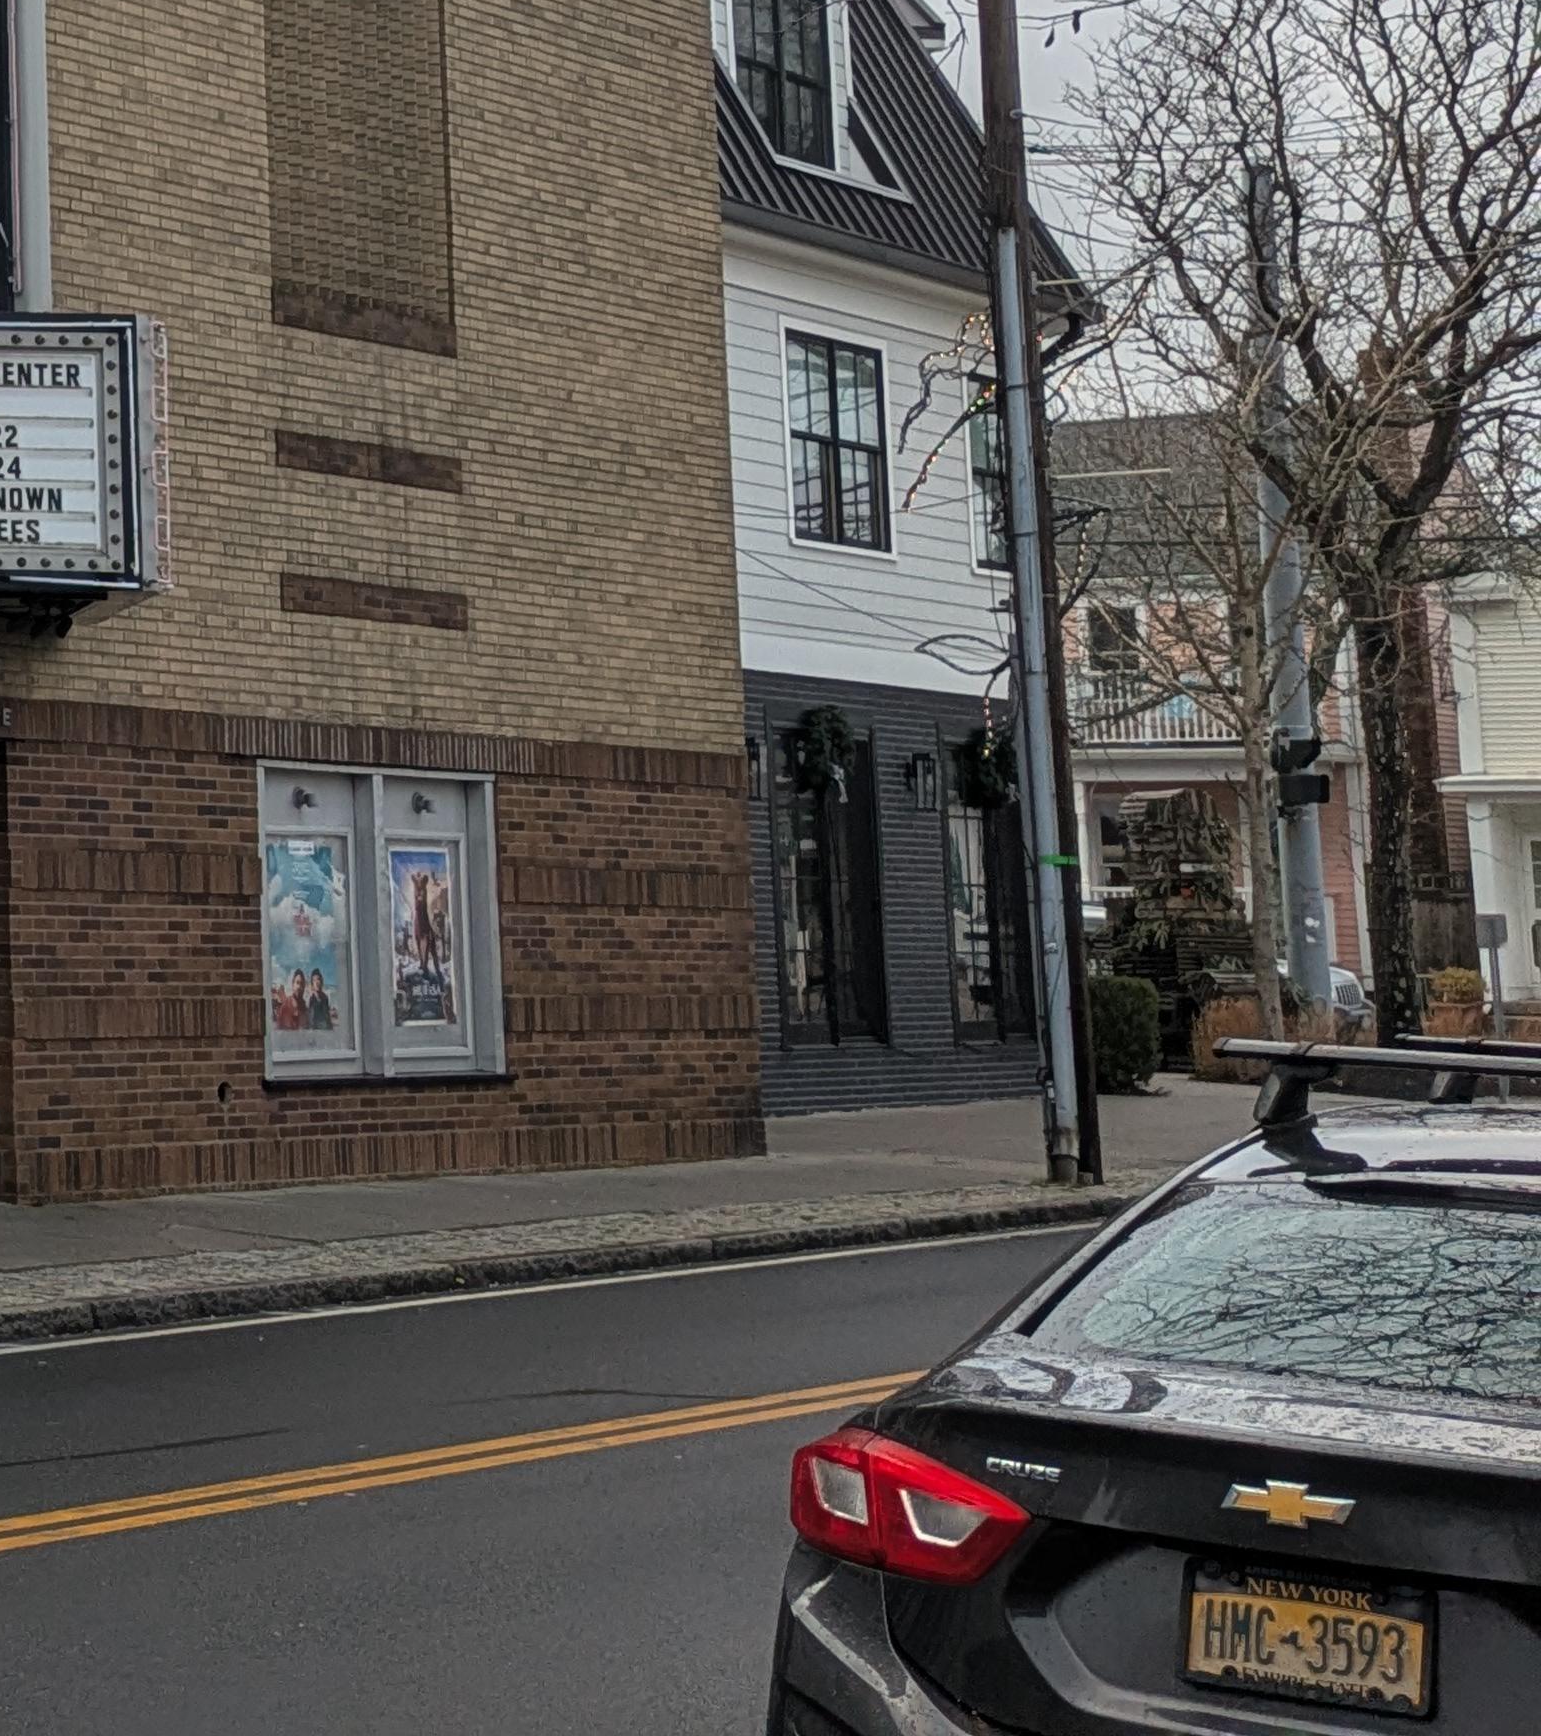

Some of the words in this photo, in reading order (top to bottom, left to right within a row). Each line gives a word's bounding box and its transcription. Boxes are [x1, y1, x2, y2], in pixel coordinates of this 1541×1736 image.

[985, 1456, 1064, 1483] CRUZE
[1246, 1576, 1303, 1600] NEW
[1308, 1584, 1373, 1612] YORK
[1203, 1597, 1277, 1666] HMC
[1305, 1613, 1406, 1685] 3593
